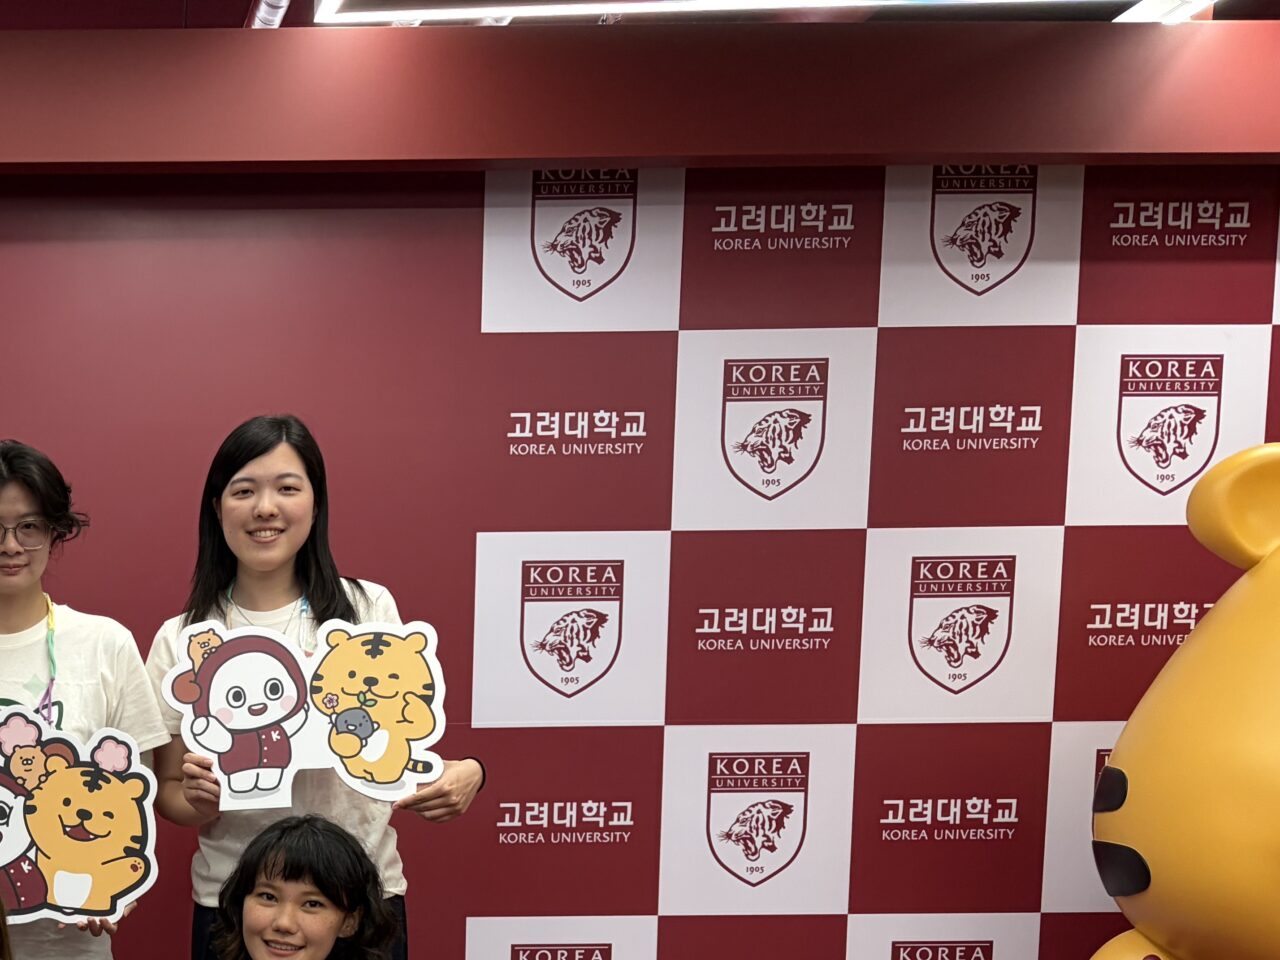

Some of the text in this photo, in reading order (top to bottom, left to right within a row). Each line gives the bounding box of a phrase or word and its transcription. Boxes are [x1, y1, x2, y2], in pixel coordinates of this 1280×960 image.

[540, 183, 630, 194] UNIVERSITY
[940, 178, 1030, 189] UNIVERSITY
[711, 202, 855, 233] 고려대학교
[1109, 200, 1251, 231] 고려대학교
[713, 236, 851, 251] KOREA UNIVERSITY
[1112, 234, 1248, 247] KOREA UNIVERSITY
[571, 278, 592, 289] 1905
[971, 273, 991, 283] 1905
[732, 364, 821, 383] KOREA
[1128, 360, 1216, 378] KOREA
[731, 386, 821, 397] UNIVERSITY
[1127, 381, 1216, 392] UNIVERSITY
[506, 409, 647, 439] 고려대학교
[900, 404, 1043, 434] 고려대학교
[509, 442, 644, 456] KOREA UNIVERSITY
[902, 437, 1039, 451] KOREA UNIVERSITY
[761, 478, 781, 489] 1905
[1155, 473, 1176, 484] 1905
[530, 566, 617, 584] KOREA
[919, 562, 1008, 579] KOREA
[529, 587, 617, 598] UNIVERSITY
[919, 583, 1009, 594] UNIVERSITY
[695, 605, 834, 635] 고려대학교
[697, 638, 831, 651] KOREA UNIVERSITY
[1088, 634, 1135, 646] KOREA
[560, 676, 580, 687] 1905
[948, 672, 968, 683] 1905
[270, 730, 283, 742] K
[716, 758, 803, 775] KOREA
[716, 778, 803, 789] UNIVERSITY
[496, 799, 634, 828] 고려대학교
[879, 796, 1019, 825] 고려대학교
[499, 831, 631, 844] KOREA UNIVERSITY
[882, 828, 1015, 841] KOREA UNIVERSITY
[20, 860, 33, 873] K
[745, 866, 765, 876] 1905
